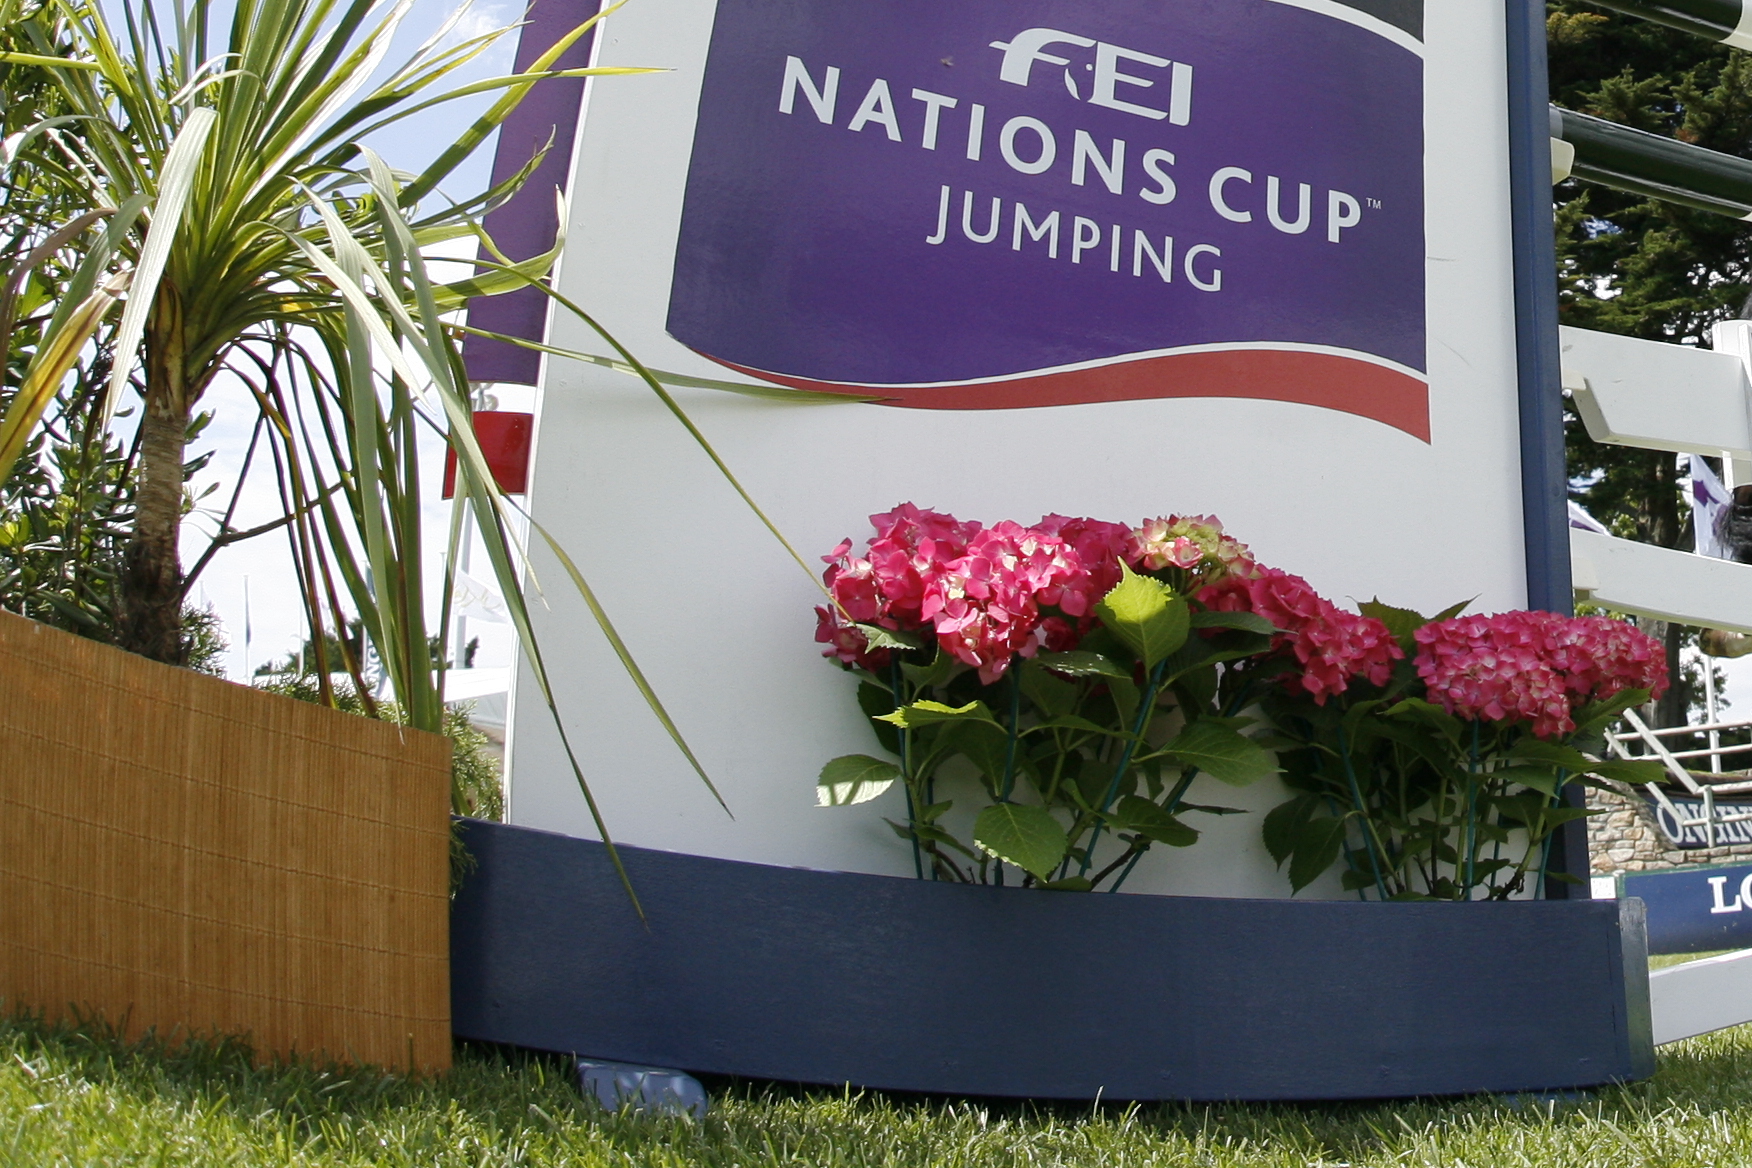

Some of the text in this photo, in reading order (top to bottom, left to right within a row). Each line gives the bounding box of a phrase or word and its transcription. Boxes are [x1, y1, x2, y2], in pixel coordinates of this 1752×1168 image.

[778, 55, 1177, 206] NATIONS
[989, 27, 1194, 126] FEI
[926, 184, 1223, 292] JUMPING
